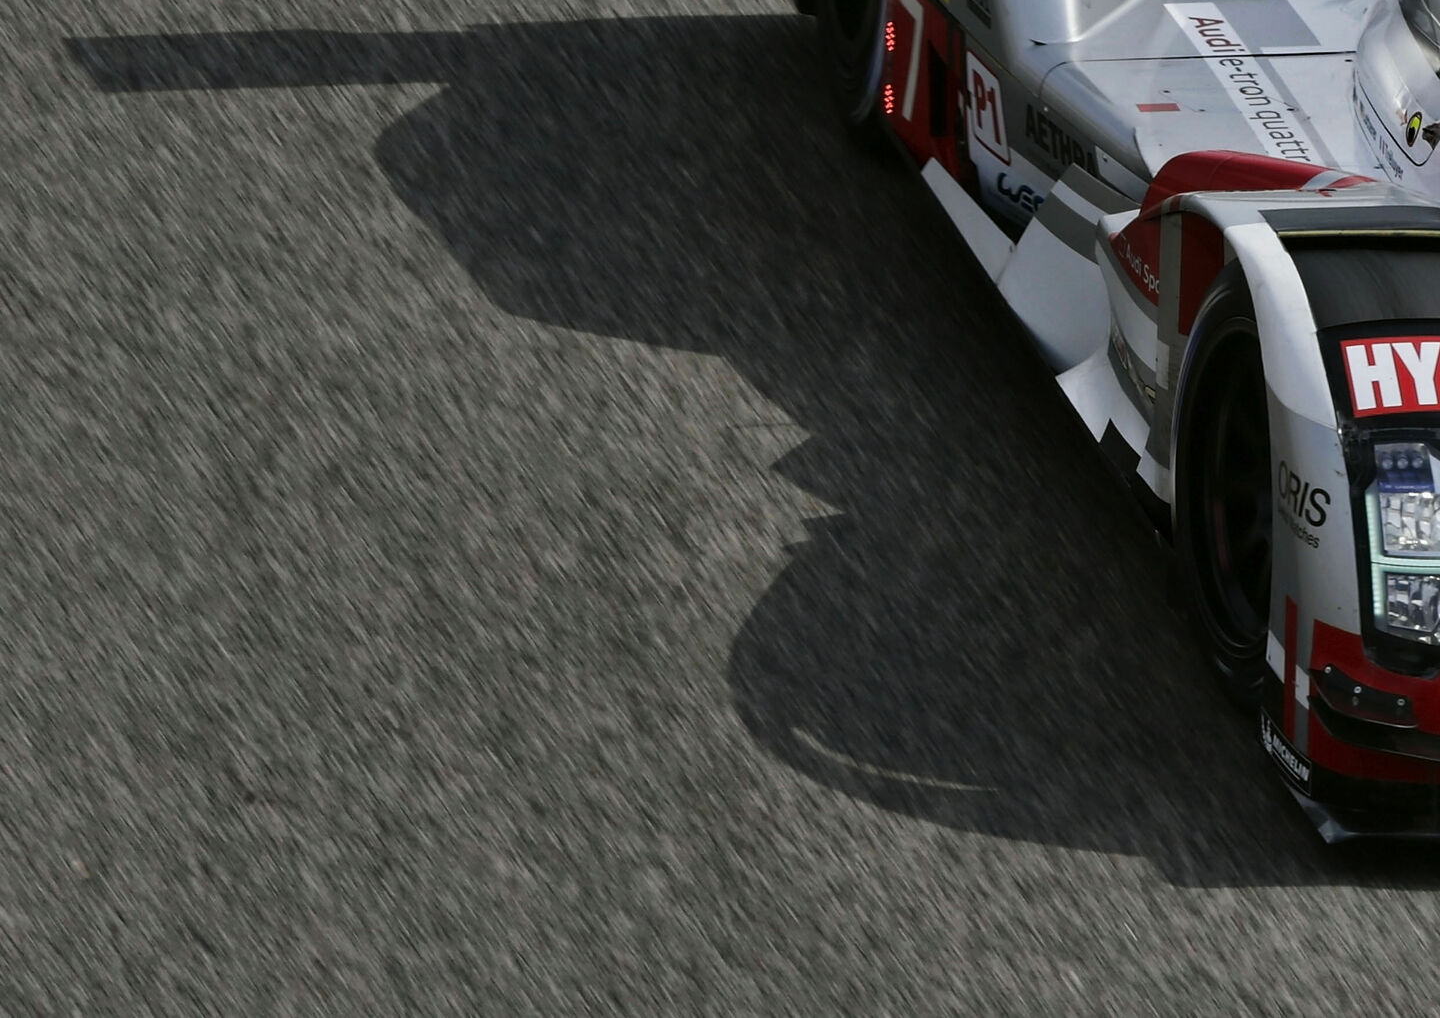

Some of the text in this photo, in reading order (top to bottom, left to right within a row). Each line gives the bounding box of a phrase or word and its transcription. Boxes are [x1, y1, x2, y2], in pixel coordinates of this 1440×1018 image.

[1187, 15, 1246, 54] Audi
[1218, 57, 1273, 107] e-tron
[971, 68, 1002, 145] P1
[1346, 342, 1440, 410] HY
[1279, 460, 1331, 528] ORIS
[1273, 734, 1310, 781] MICHELIN
